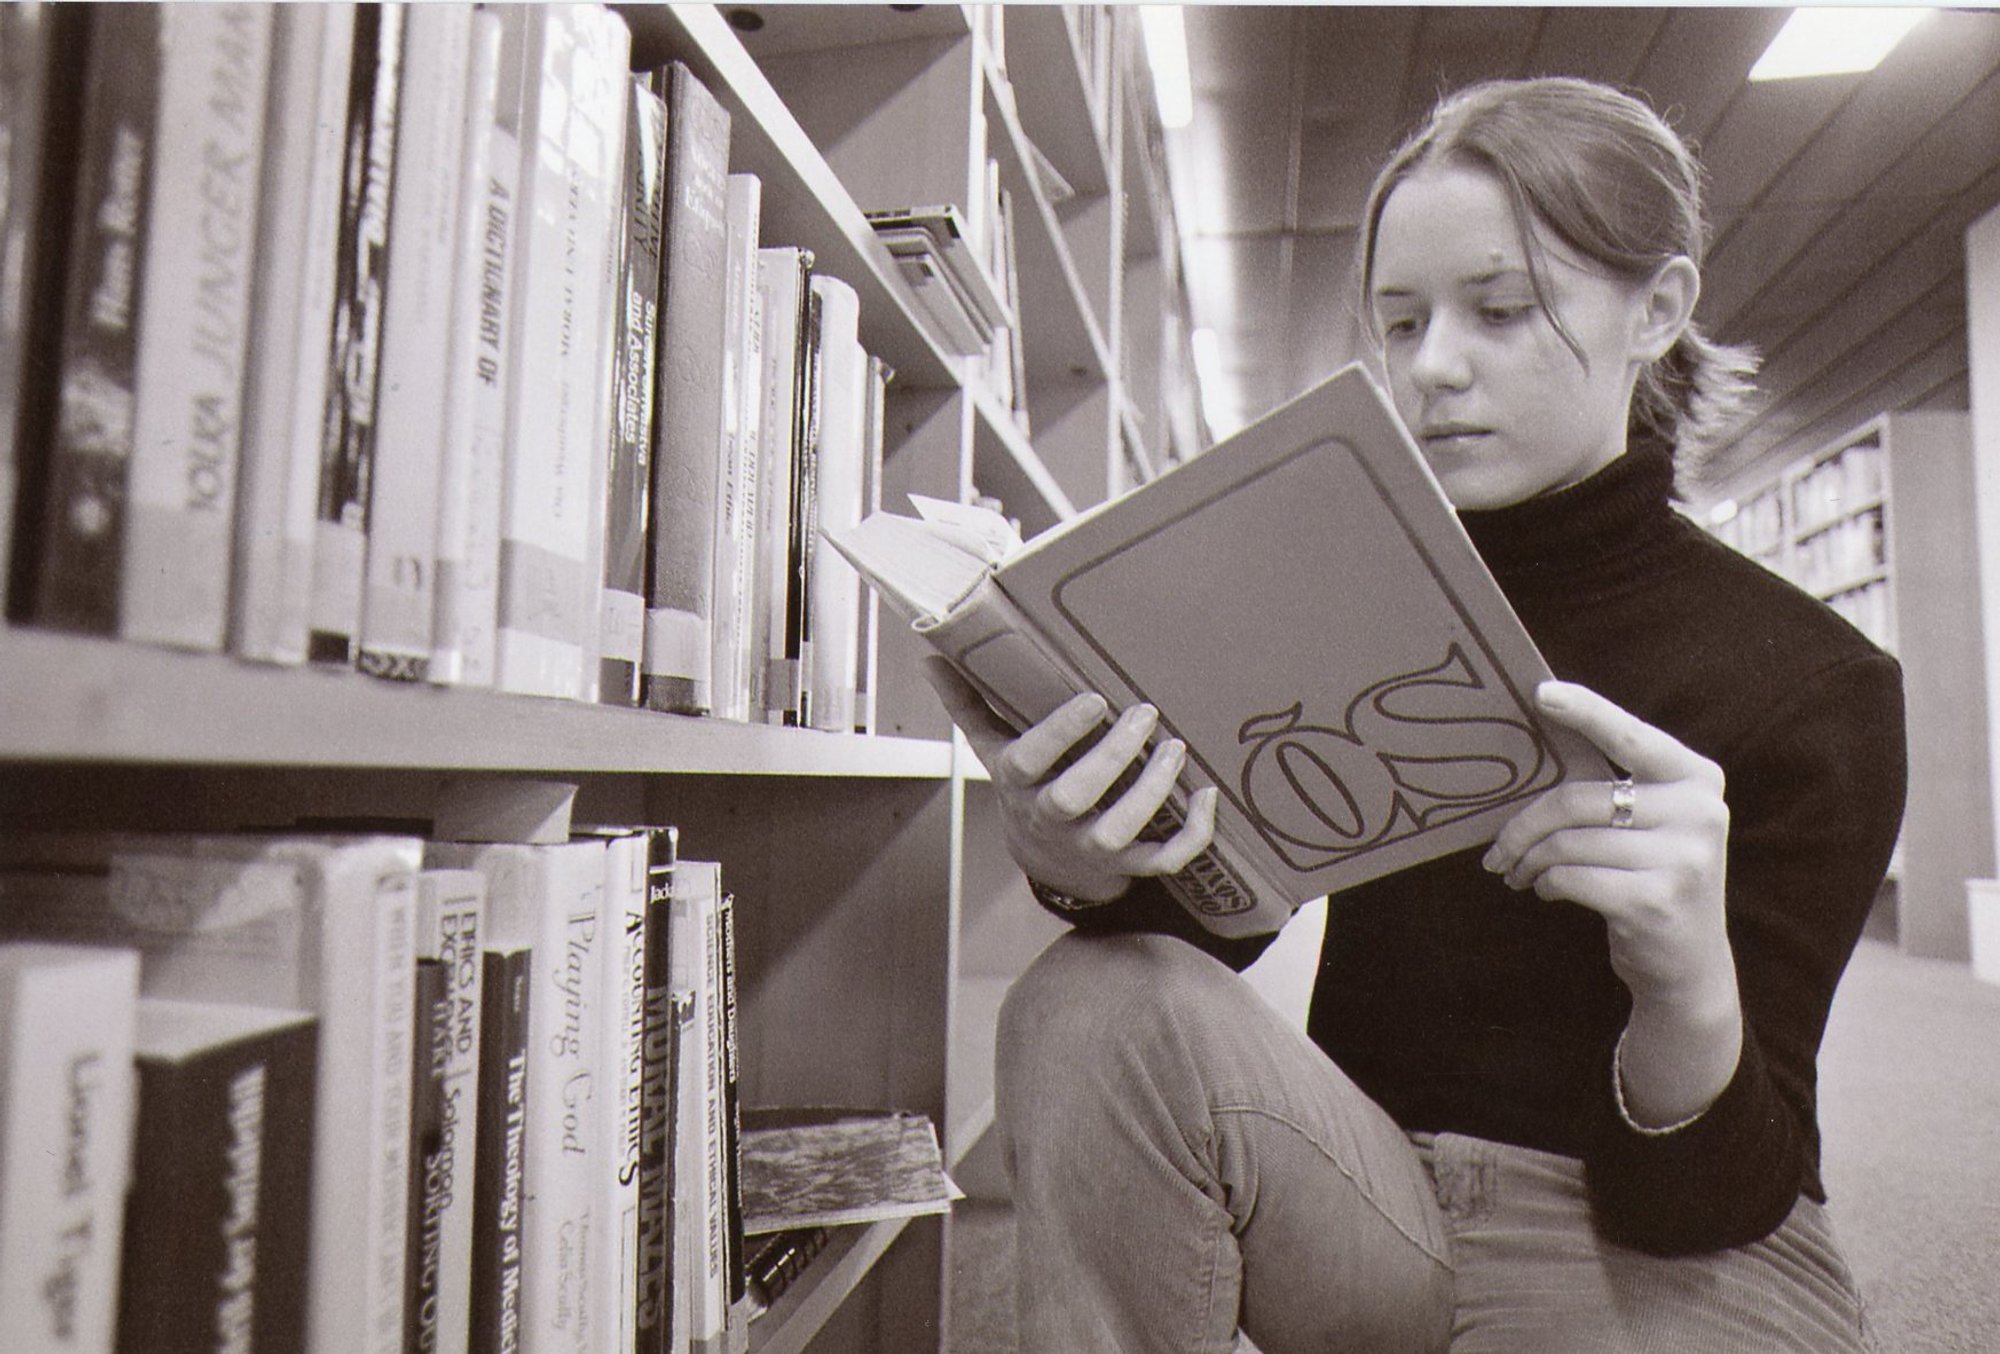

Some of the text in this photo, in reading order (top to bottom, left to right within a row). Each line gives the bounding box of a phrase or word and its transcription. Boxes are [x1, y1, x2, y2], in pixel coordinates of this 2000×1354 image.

[477, 178, 509, 388] A DICTIONARY OF
[625, 291, 643, 445] and Associates
[457, 912, 476, 1054] ETHICS AND
[550, 910, 596, 1157] Playing God
[619, 912, 644, 1186] ACCOUNTING ETHICS
[725, 909, 736, 1083] Mothers and Daughters
[439, 1088, 461, 1211] Solomon
[507, 1049, 525, 1105] The
[706, 913, 718, 1278] SCIENCE EDUCATION AND ETHICAL VALUES
[422, 1153, 442, 1291] SORTING
[499, 1102, 523, 1232] Theology
[503, 1235, 519, 1263] of
[638, 1164, 665, 1330] MAZES
